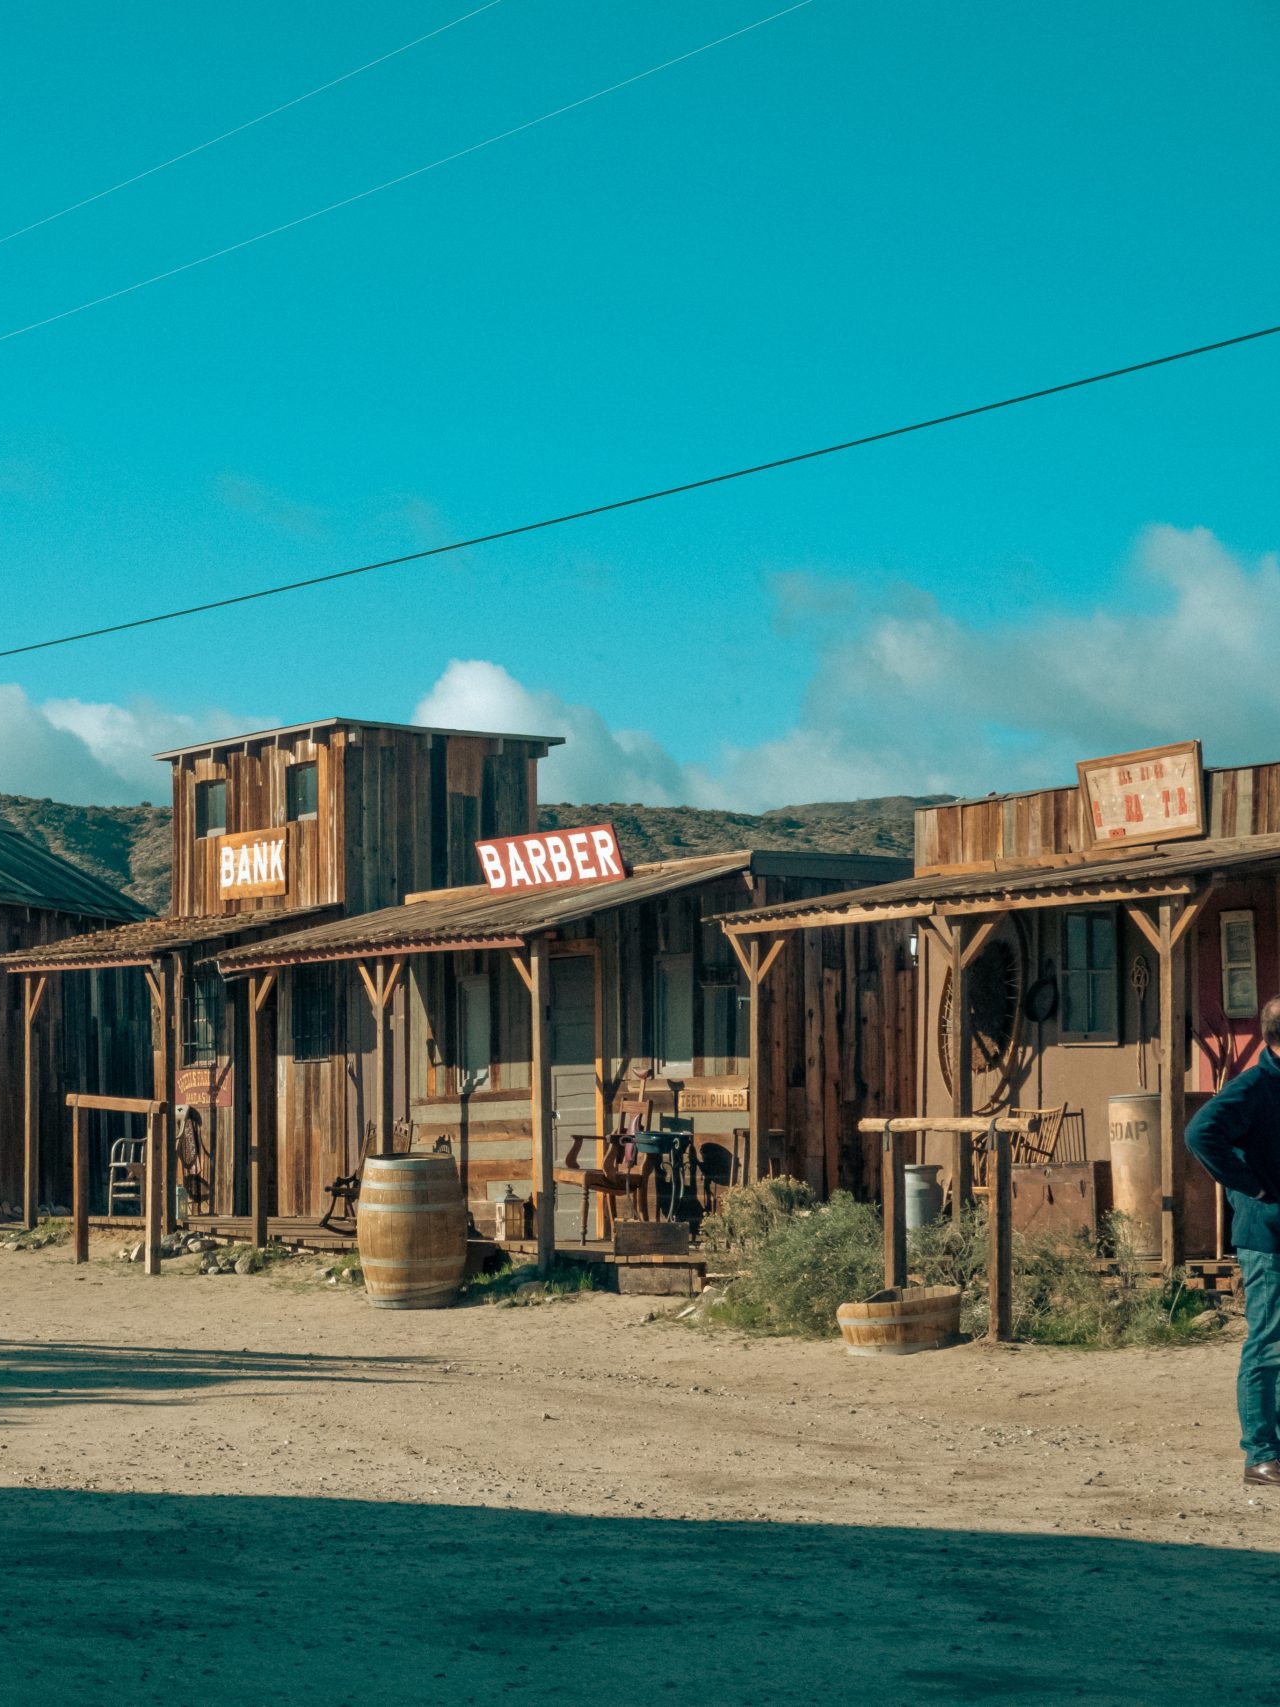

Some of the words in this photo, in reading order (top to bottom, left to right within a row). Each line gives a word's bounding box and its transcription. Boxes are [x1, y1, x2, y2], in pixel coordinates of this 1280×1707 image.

[221, 839, 285, 888] BANK
[478, 829, 621, 889] BARBER
[681, 1094, 706, 1107] TEETH
[711, 1093, 744, 1107] PULLED
[1110, 1120, 1148, 1142] SOAP
